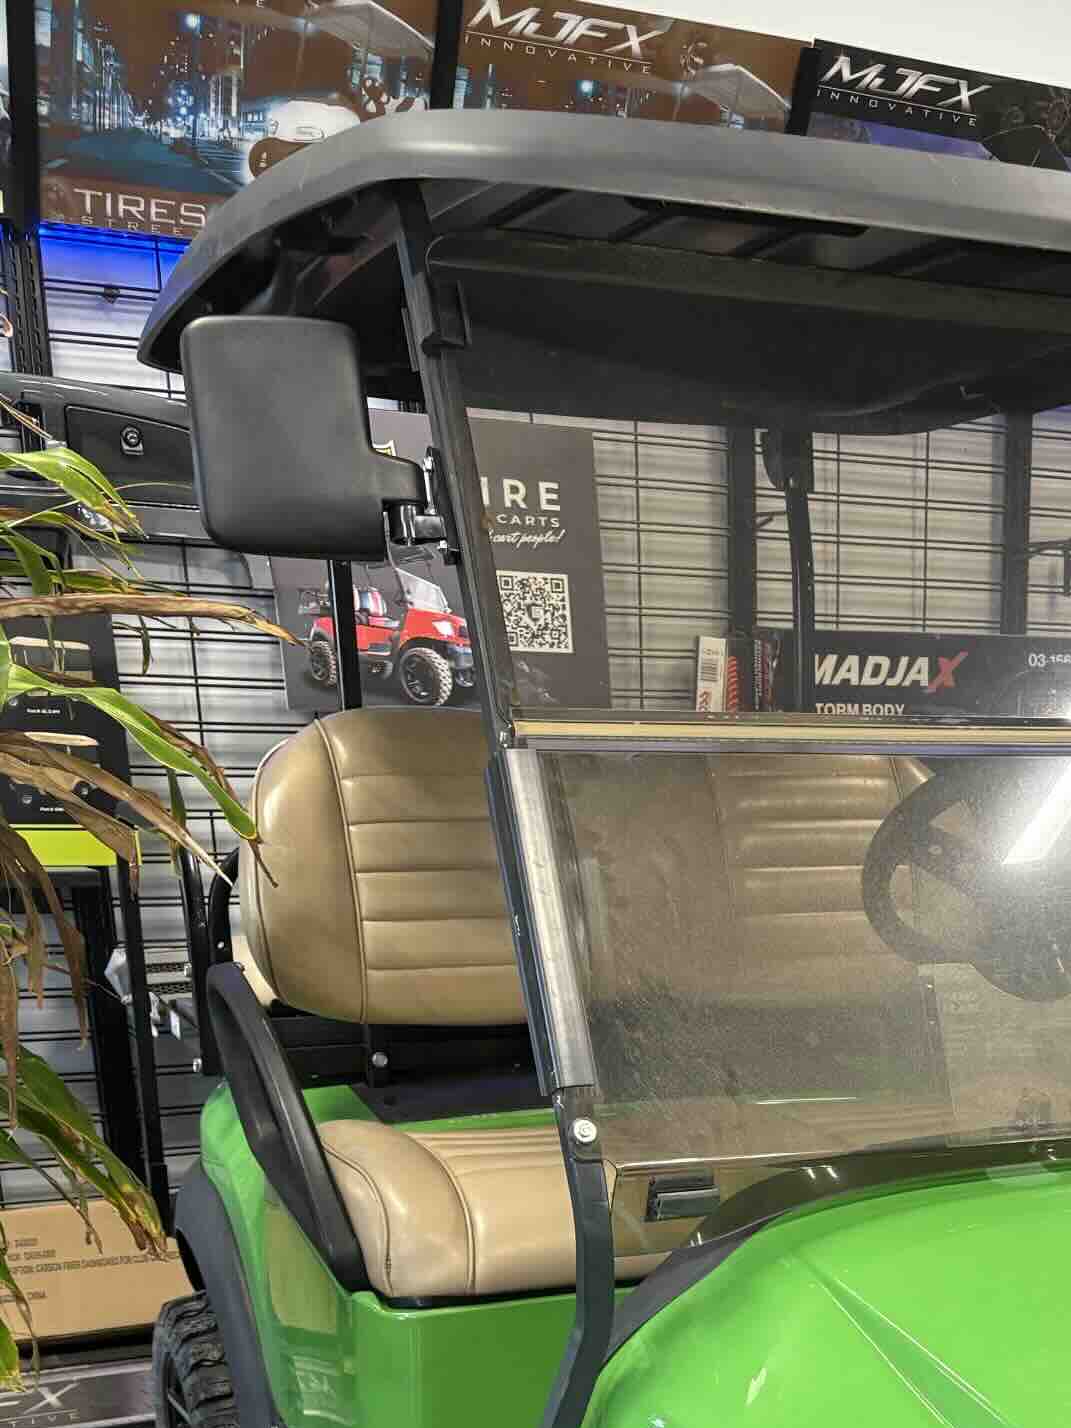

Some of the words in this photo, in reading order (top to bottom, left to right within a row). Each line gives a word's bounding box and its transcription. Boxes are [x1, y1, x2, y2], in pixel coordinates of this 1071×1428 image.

[464, 34, 651, 74] INNOVATIVE
[820, 55, 993, 113] MJFX
[816, 89, 977, 127] INNOVATIVE
[73, 188, 206, 226] TIRES
[496, 514, 561, 528] CARTS
[815, 651, 969, 694] MADJAX
